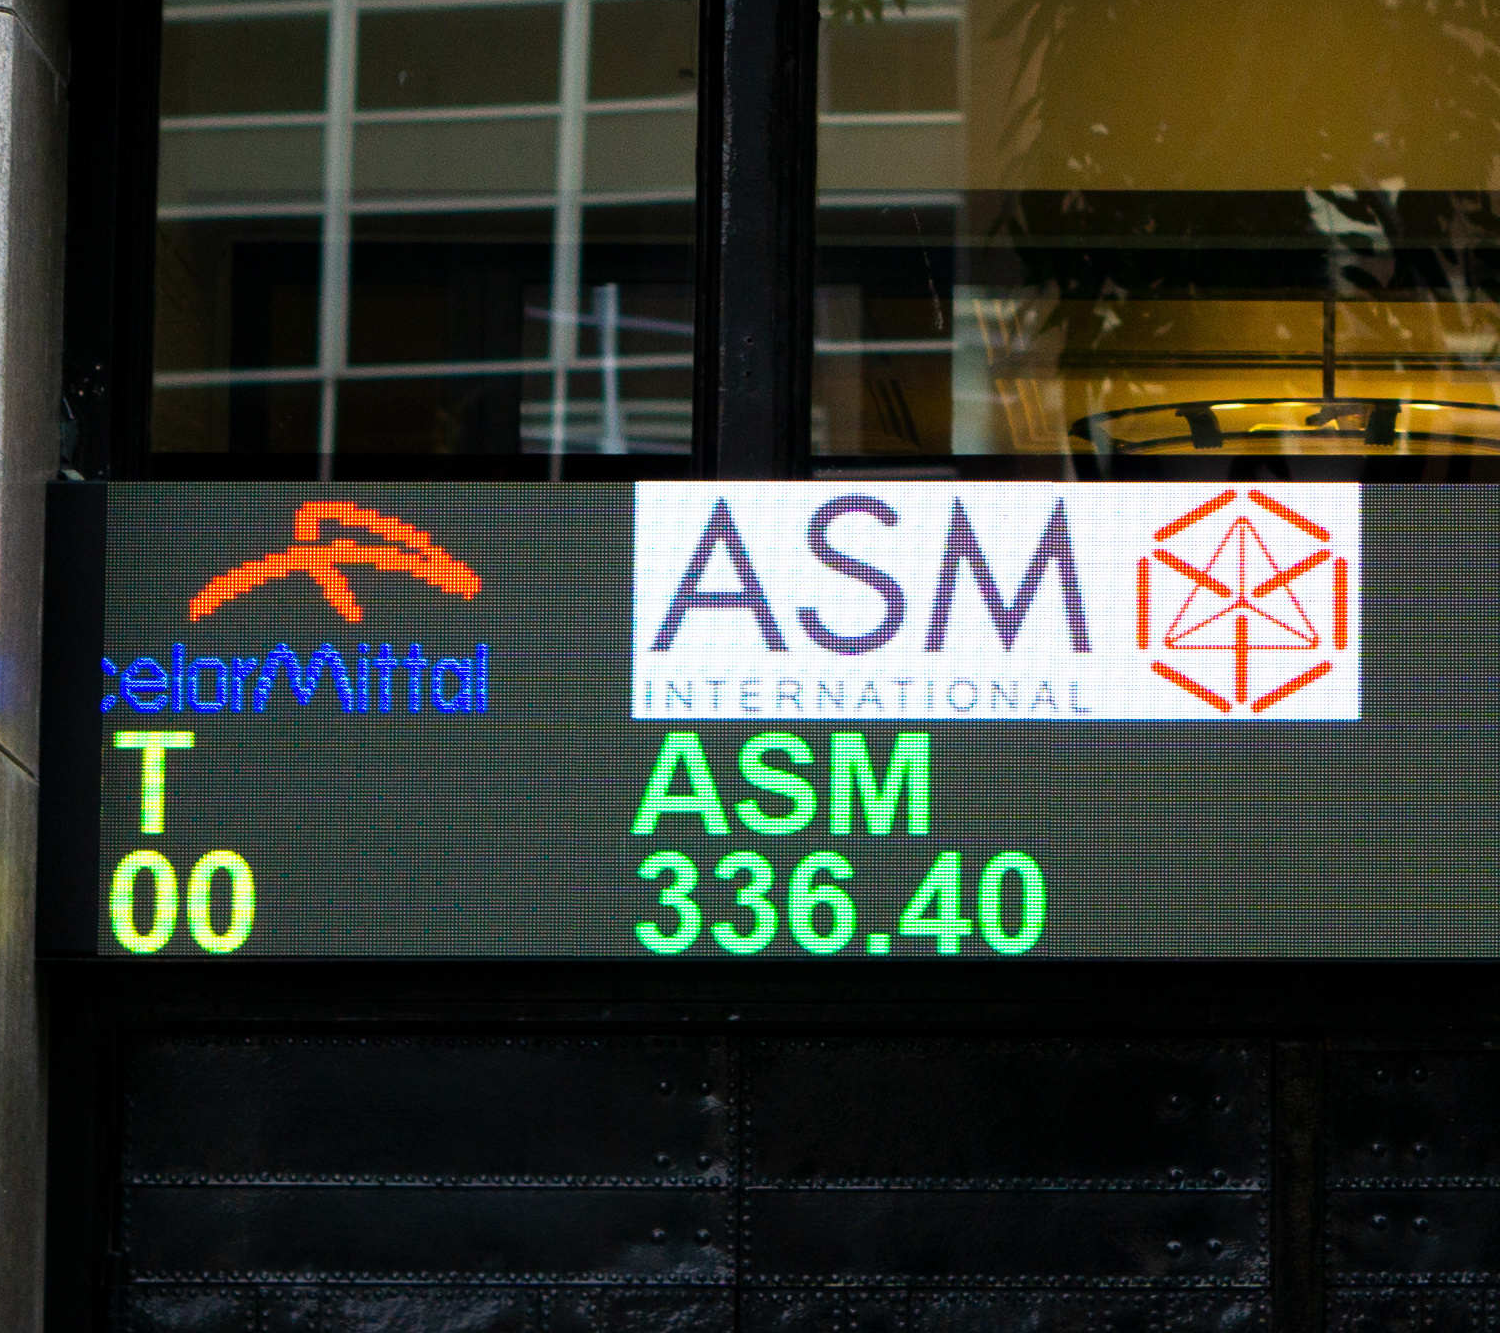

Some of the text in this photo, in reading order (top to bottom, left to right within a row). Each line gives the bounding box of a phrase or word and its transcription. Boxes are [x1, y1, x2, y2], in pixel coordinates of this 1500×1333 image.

[649, 493, 1094, 655] ASM
[644, 678, 1092, 713] INTERNATIONAL
[113, 730, 195, 834] T
[630, 731, 931, 835] ASM
[109, 849, 256, 954] 00
[634, 850, 1047, 955] 336.40
